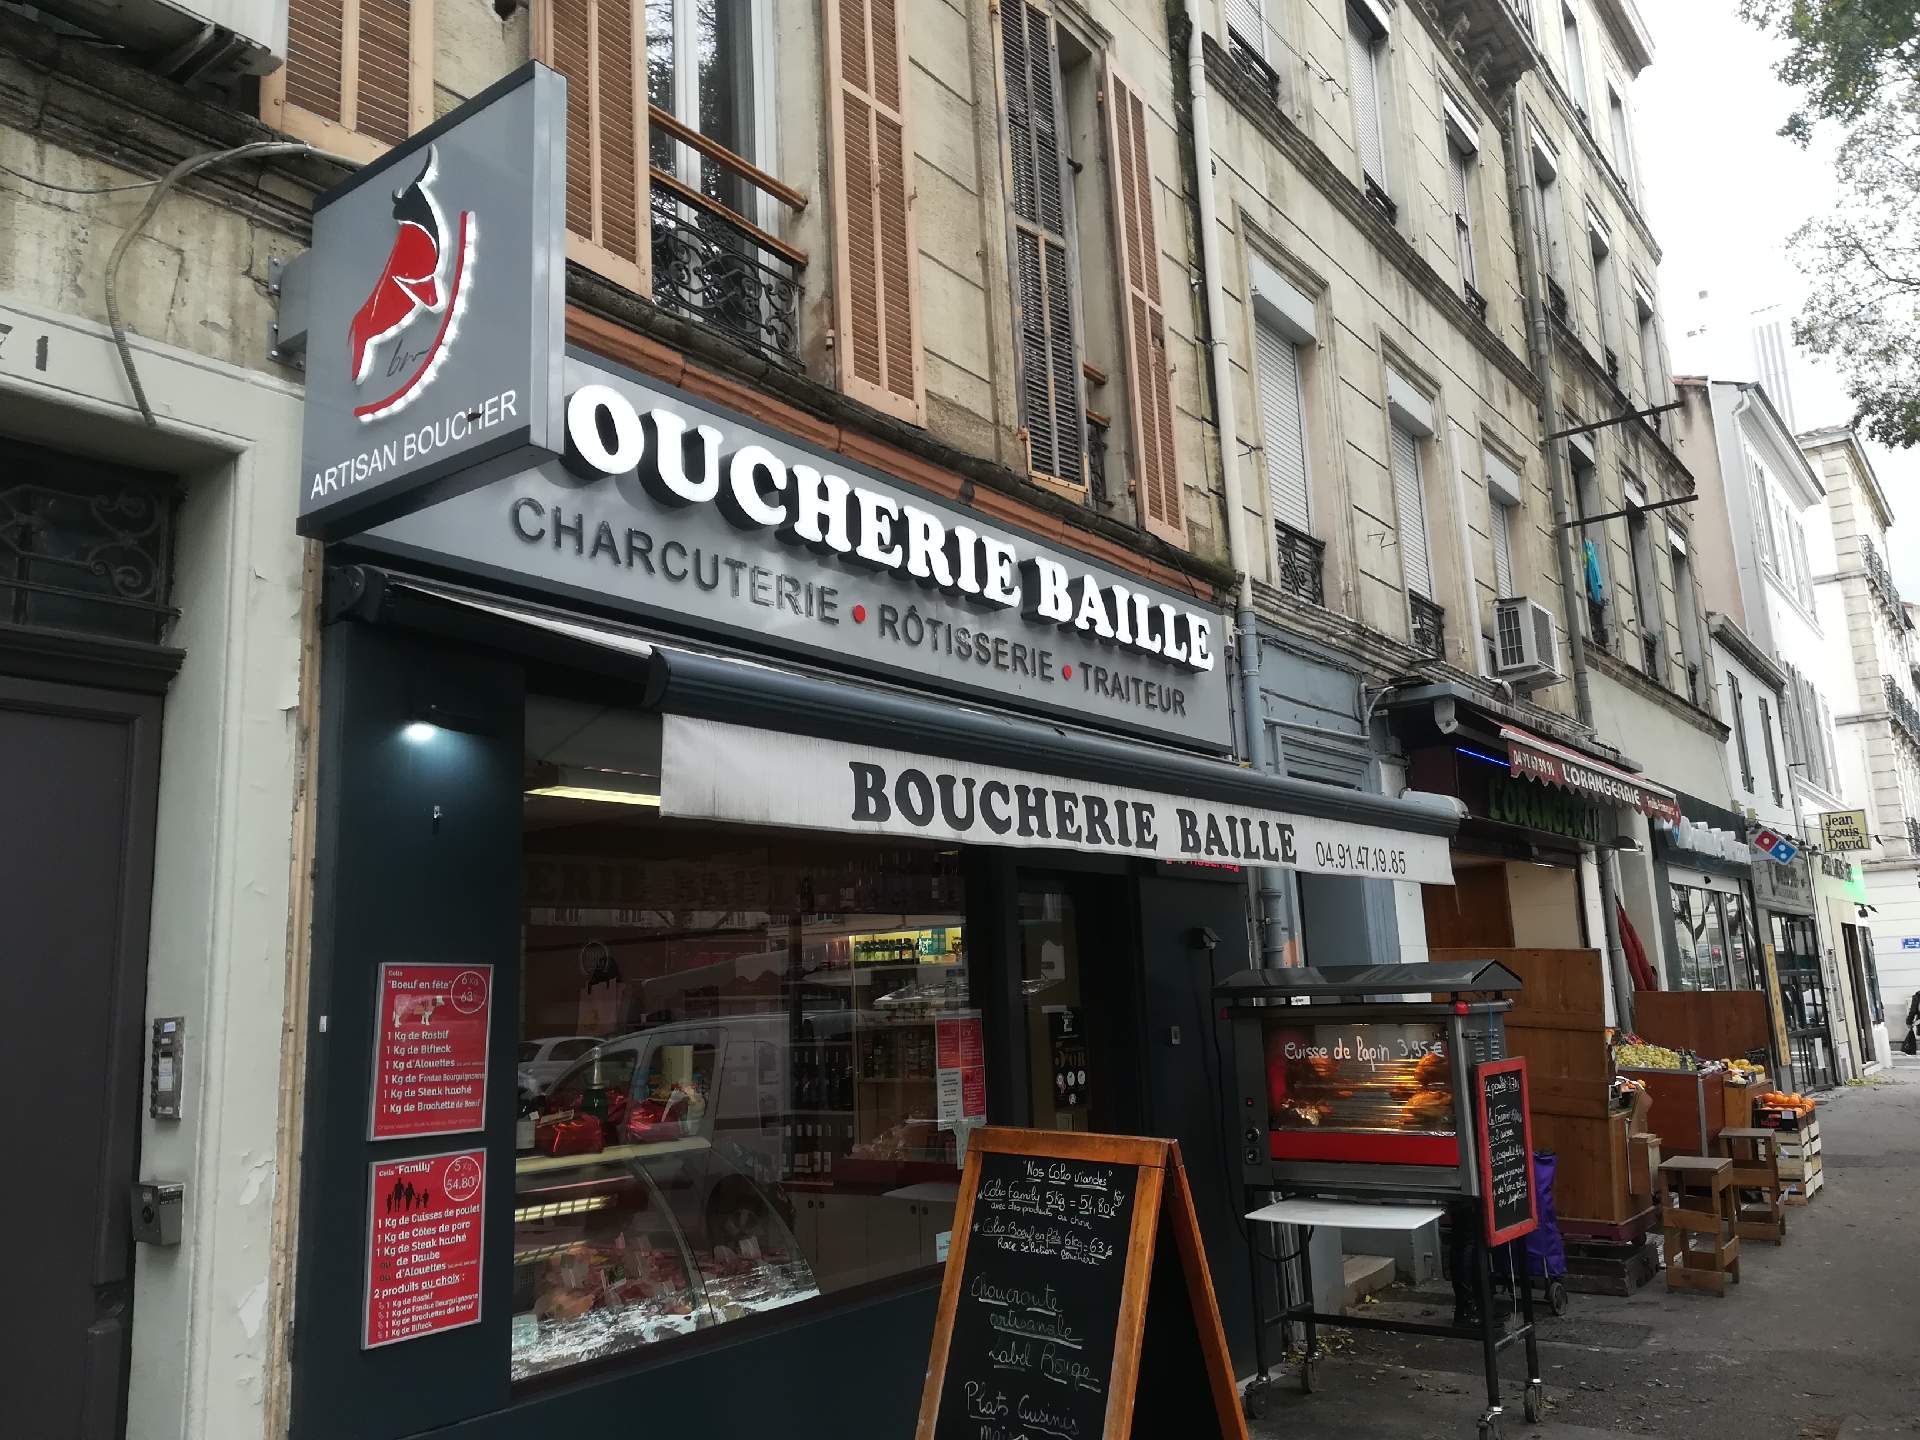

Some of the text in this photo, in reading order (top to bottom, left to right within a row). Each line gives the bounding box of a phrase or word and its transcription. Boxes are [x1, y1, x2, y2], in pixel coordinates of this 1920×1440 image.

[310, 390, 517, 500] ARTISAN BOUCHER
[567, 384, 1215, 671] OUCHERIE BAILLE
[512, 497, 1187, 717] CHARCUTERIE RÔTISSERIE TRAITEUR
[849, 761, 1407, 875] BOUCHERIE BAILLE 04.91.47.19.85
[1825, 815, 1853, 826] Jean
[1826, 825, 1859, 839] Louis
[1828, 836, 1864, 850] David
[419, 981, 430, 989] en
[394, 1032, 406, 1042] Kg
[408, 1032, 420, 1040] de
[422, 1030, 449, 1039] Rosbif
[393, 1046, 405, 1056] Kg
[407, 1045, 418, 1054] de
[421, 1045, 451, 1053] Bifteck
[1284, 1041, 1328, 1060] Cuisse
[1333, 1037, 1351, 1060] de
[392, 1061, 405, 1071] Kg
[406, 1059, 455, 1068] d'Alouettes
[391, 1075, 403, 1085] Kg
[406, 1074, 417, 1083] de
[390, 1089, 402, 1100] Kg
[405, 1089, 416, 1097] de
[418, 1087, 443, 1096] Steak
[445, 1085, 472, 1095] haché
[390, 1104, 401, 1114] Kg
[404, 1103, 415, 1112] de
[1008, 1180, 1040, 1203] Family
[385, 1217, 397, 1229] Kg
[399, 1216, 410, 1225] de
[411, 1211, 443, 1223] Cuisses
[444, 1209, 454, 1218] de
[455, 1204, 480, 1218] poulet
[384, 1232, 396, 1243] Kg
[398, 1231, 410, 1240] de
[439, 1224, 450, 1232] de
[452, 1221, 471, 1233] porc
[384, 1246, 396, 1257] Kg
[398, 1244, 409, 1253] de
[411, 1239, 437, 1251] Steak
[396, 1257, 408, 1266] de
[411, 1252, 440, 1263] Daube
[395, 1263, 446, 1279] d'Alouettes
[374, 1289, 380, 1299] 2
[382, 1282, 419, 1298] produits
[421, 1280, 433, 1290] au
[435, 1273, 460, 1287] choix
[971, 1272, 1064, 1313] Choucroute
[1040, 1342, 1100, 1391] Rouge
[965, 1381, 1009, 1416] Plats
